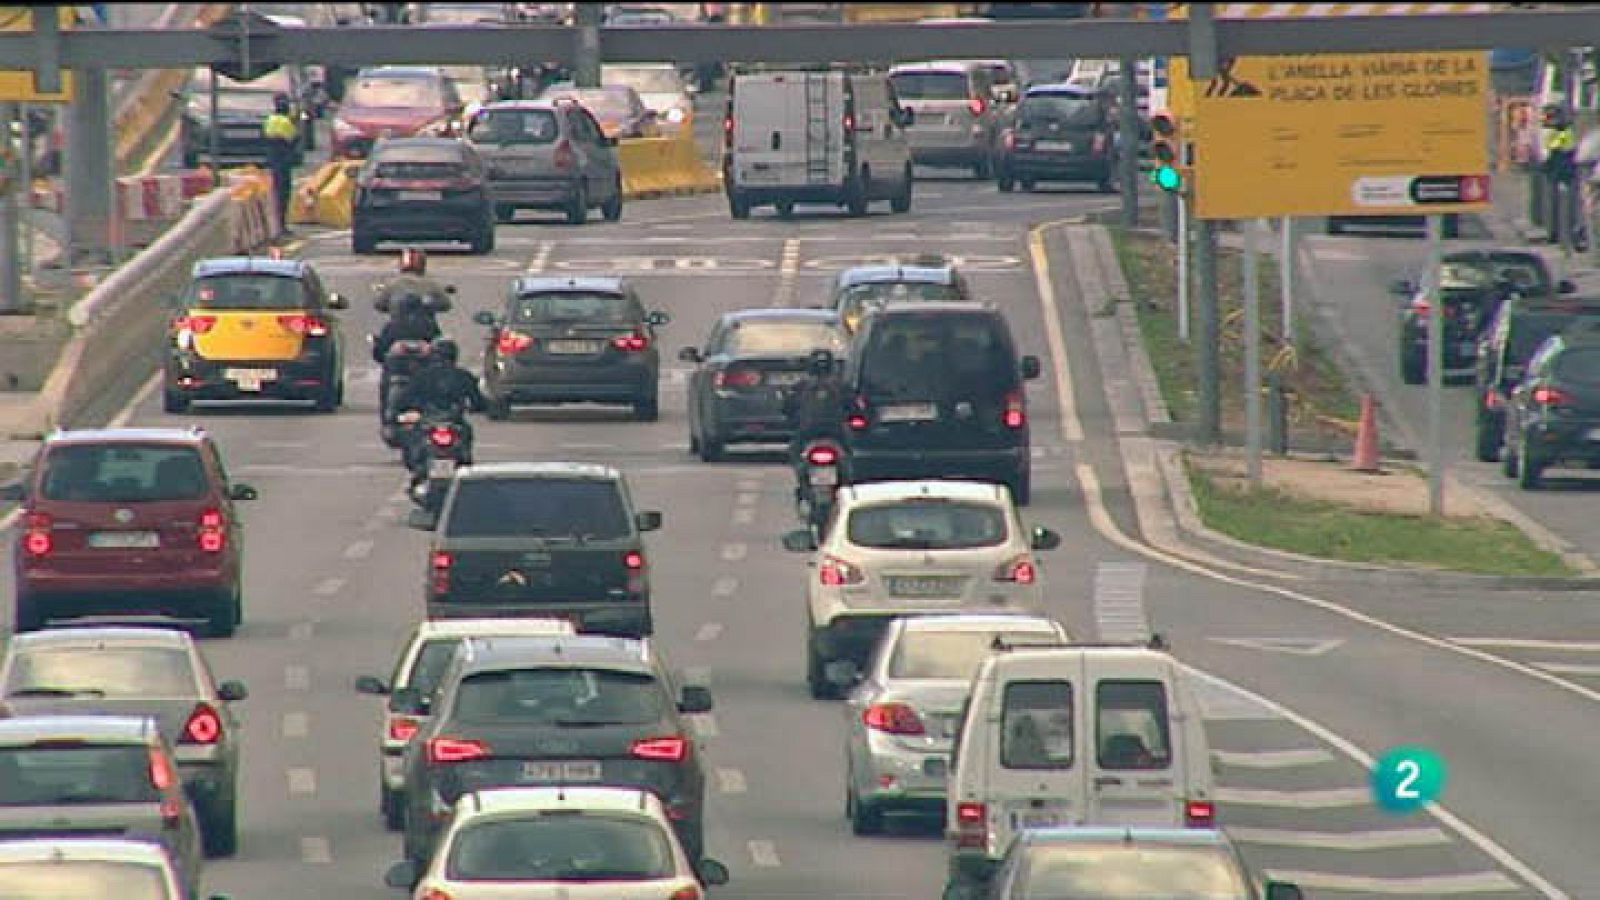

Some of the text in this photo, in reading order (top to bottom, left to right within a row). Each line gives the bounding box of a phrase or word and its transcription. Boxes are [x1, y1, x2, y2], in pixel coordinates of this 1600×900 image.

[1424, 57, 1447, 75] DE
[1454, 56, 1476, 74] LA
[1332, 82, 1354, 100] DE
